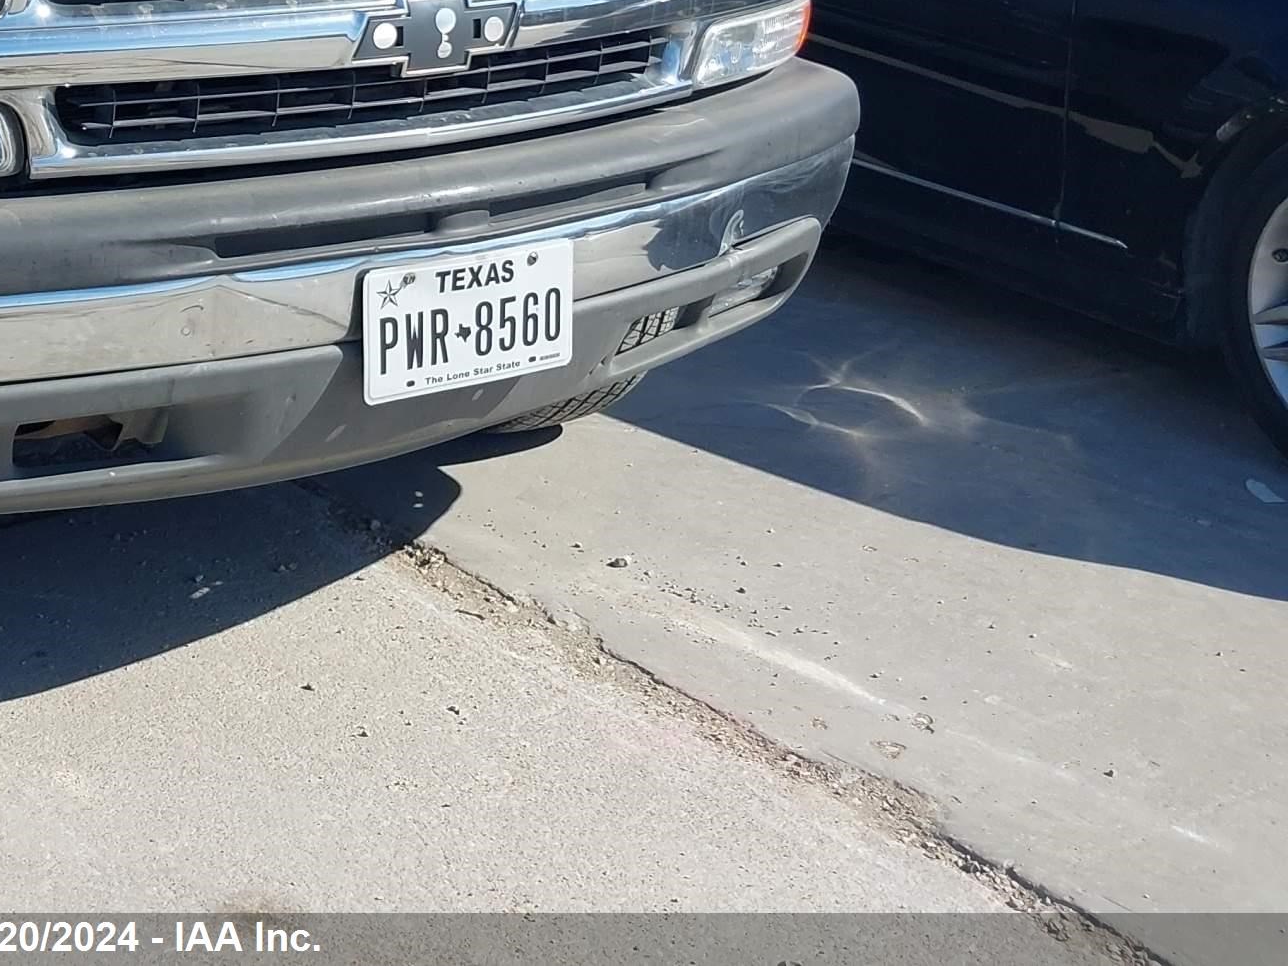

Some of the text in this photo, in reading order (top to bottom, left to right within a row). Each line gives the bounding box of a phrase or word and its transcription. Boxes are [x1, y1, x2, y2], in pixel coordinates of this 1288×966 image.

[435, 260, 515, 294] TEXAS
[379, 287, 561, 375] PWR 8560
[425, 360, 521, 386] The Lone Star State
